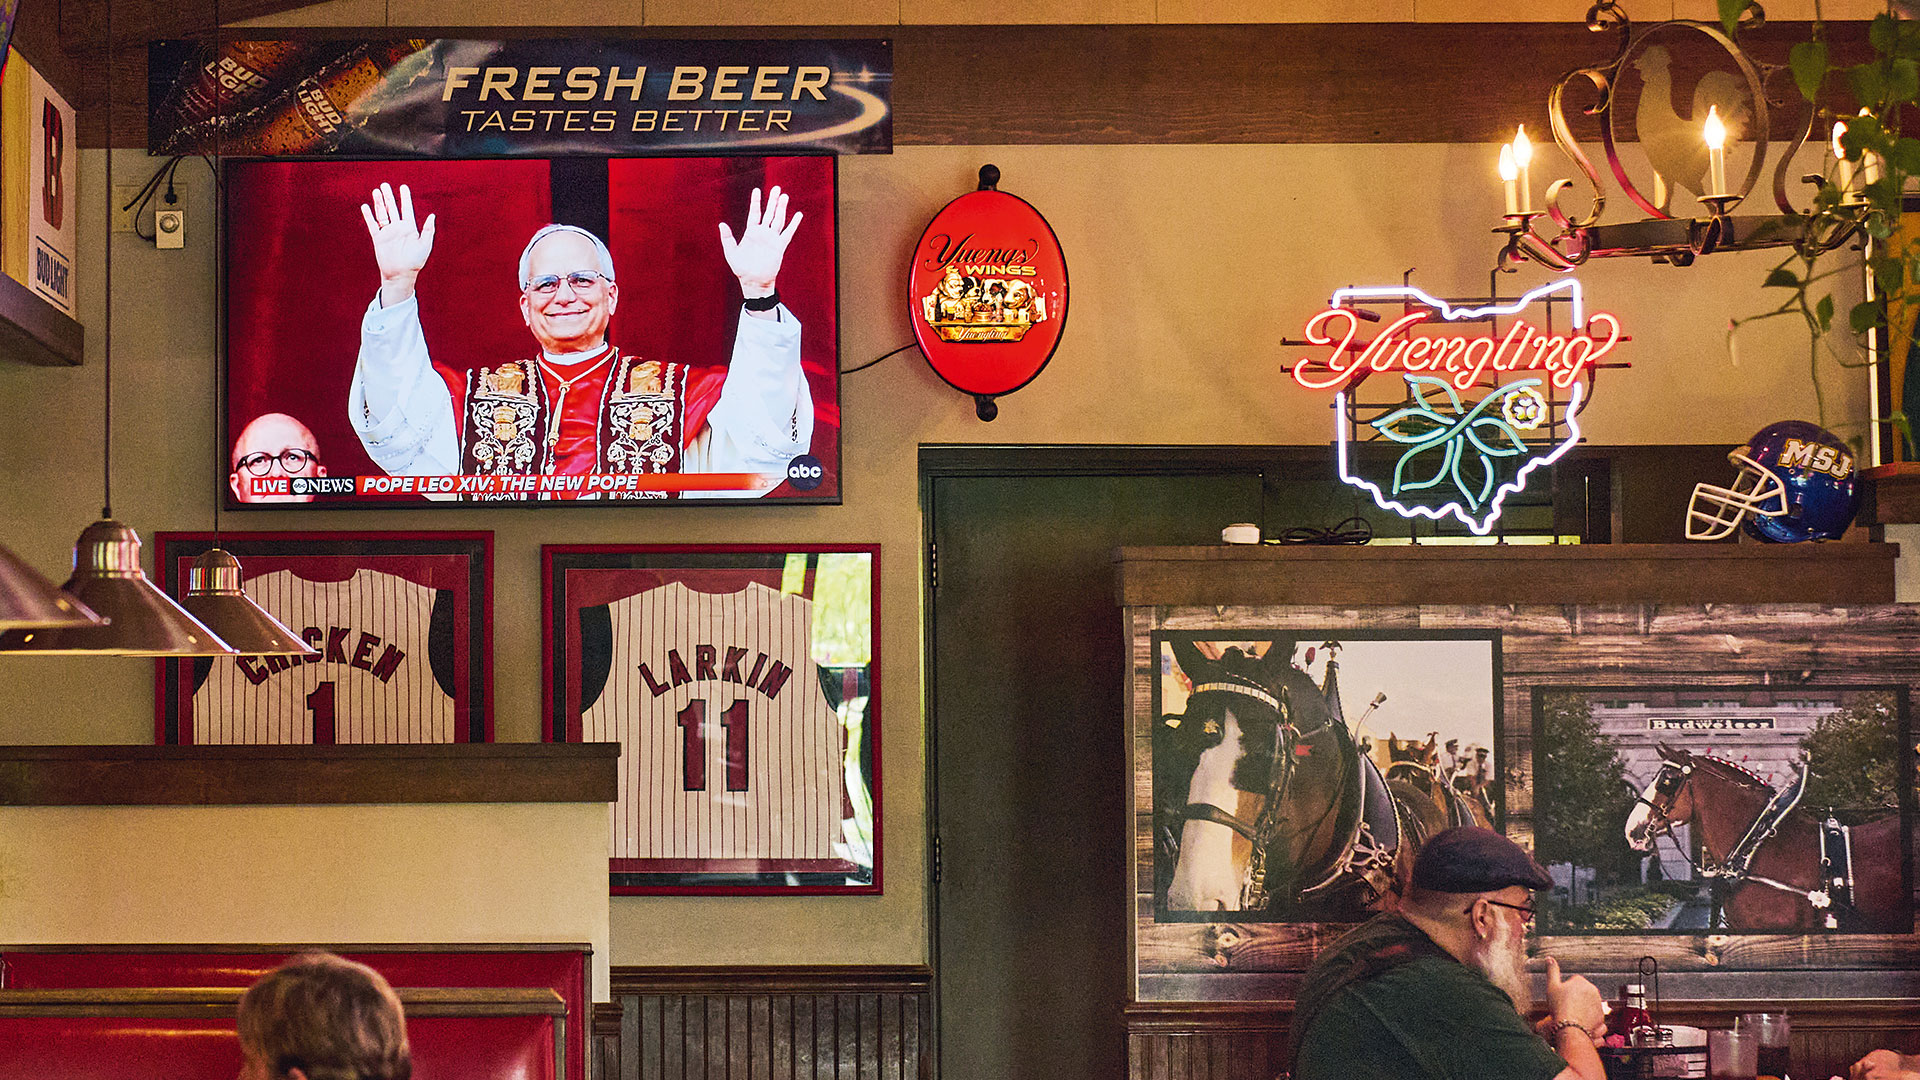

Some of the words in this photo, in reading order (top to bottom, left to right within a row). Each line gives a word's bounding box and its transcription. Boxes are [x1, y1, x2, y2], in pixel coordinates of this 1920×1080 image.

[205, 61, 248, 94] LIG
[219, 56, 269, 88] BUD
[442, 66, 647, 101] FRESH
[667, 66, 831, 101] BEER
[298, 89, 338, 135] LIGHT
[310, 88, 343, 125] BUD
[461, 110, 617, 132] TASTES
[631, 110, 792, 132] BETTER
[42, 97, 63, 231] B
[925, 233, 1039, 272] Yuengs
[945, 265, 959, 274] &
[965, 265, 1037, 276] WINGS
[37, 247, 50, 287] BUD
[50, 257, 69, 299] LIGHT
[1293, 308, 1621, 390] Yuengling
[789, 463, 822, 478] abc
[1777, 439, 1853, 480] MSJ
[253, 479, 288, 493] LIVE
[307, 478, 354, 493] NEWS
[363, 477, 413, 493] POPE
[417, 477, 454, 492] LEO
[456, 476, 495, 492] XIV:
[500, 476, 536, 491] THE
[540, 476, 585, 491] NEW
[587, 475, 639, 491] POPE
[638, 644, 793, 700] LARKIN
[306, 681, 336, 745] 1
[1652, 719, 1770, 730] Budweiser
[677, 698, 750, 792] 11
